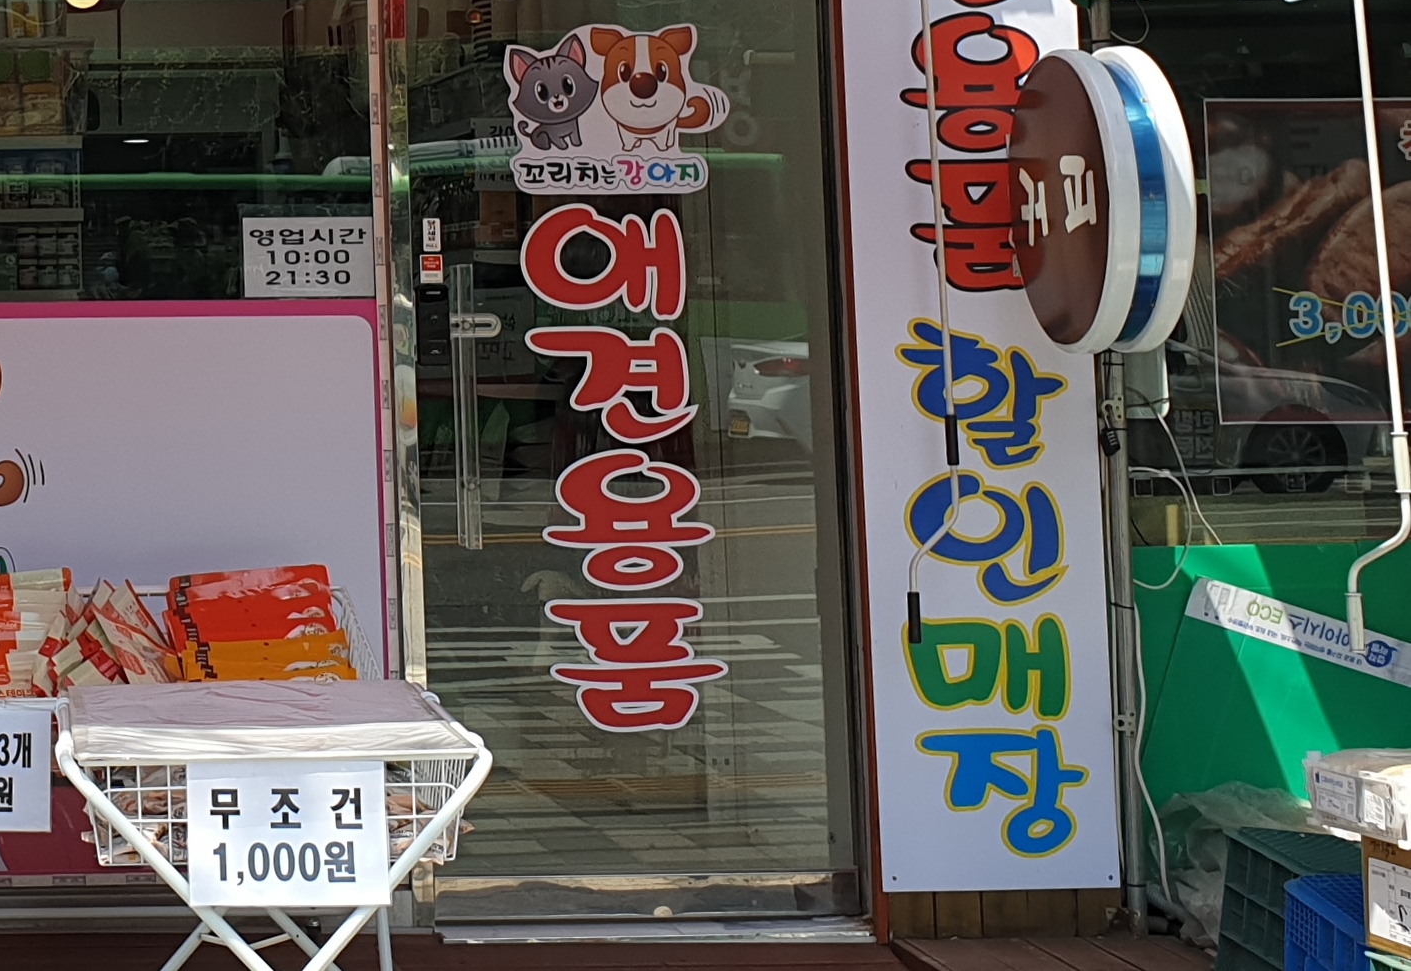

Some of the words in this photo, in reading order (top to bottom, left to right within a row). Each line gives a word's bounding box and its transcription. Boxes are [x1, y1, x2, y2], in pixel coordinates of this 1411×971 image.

[249, 228, 366, 246] 영업시간
[267, 250, 350, 265] 10:00
[265, 270, 350, 285] 21:30
[522, 203, 727, 732] 애견용품
[896, 318, 1089, 857] 할인매장
[1246, 601, 1284, 624] ECO
[213, 841, 357, 886] 1,000원
